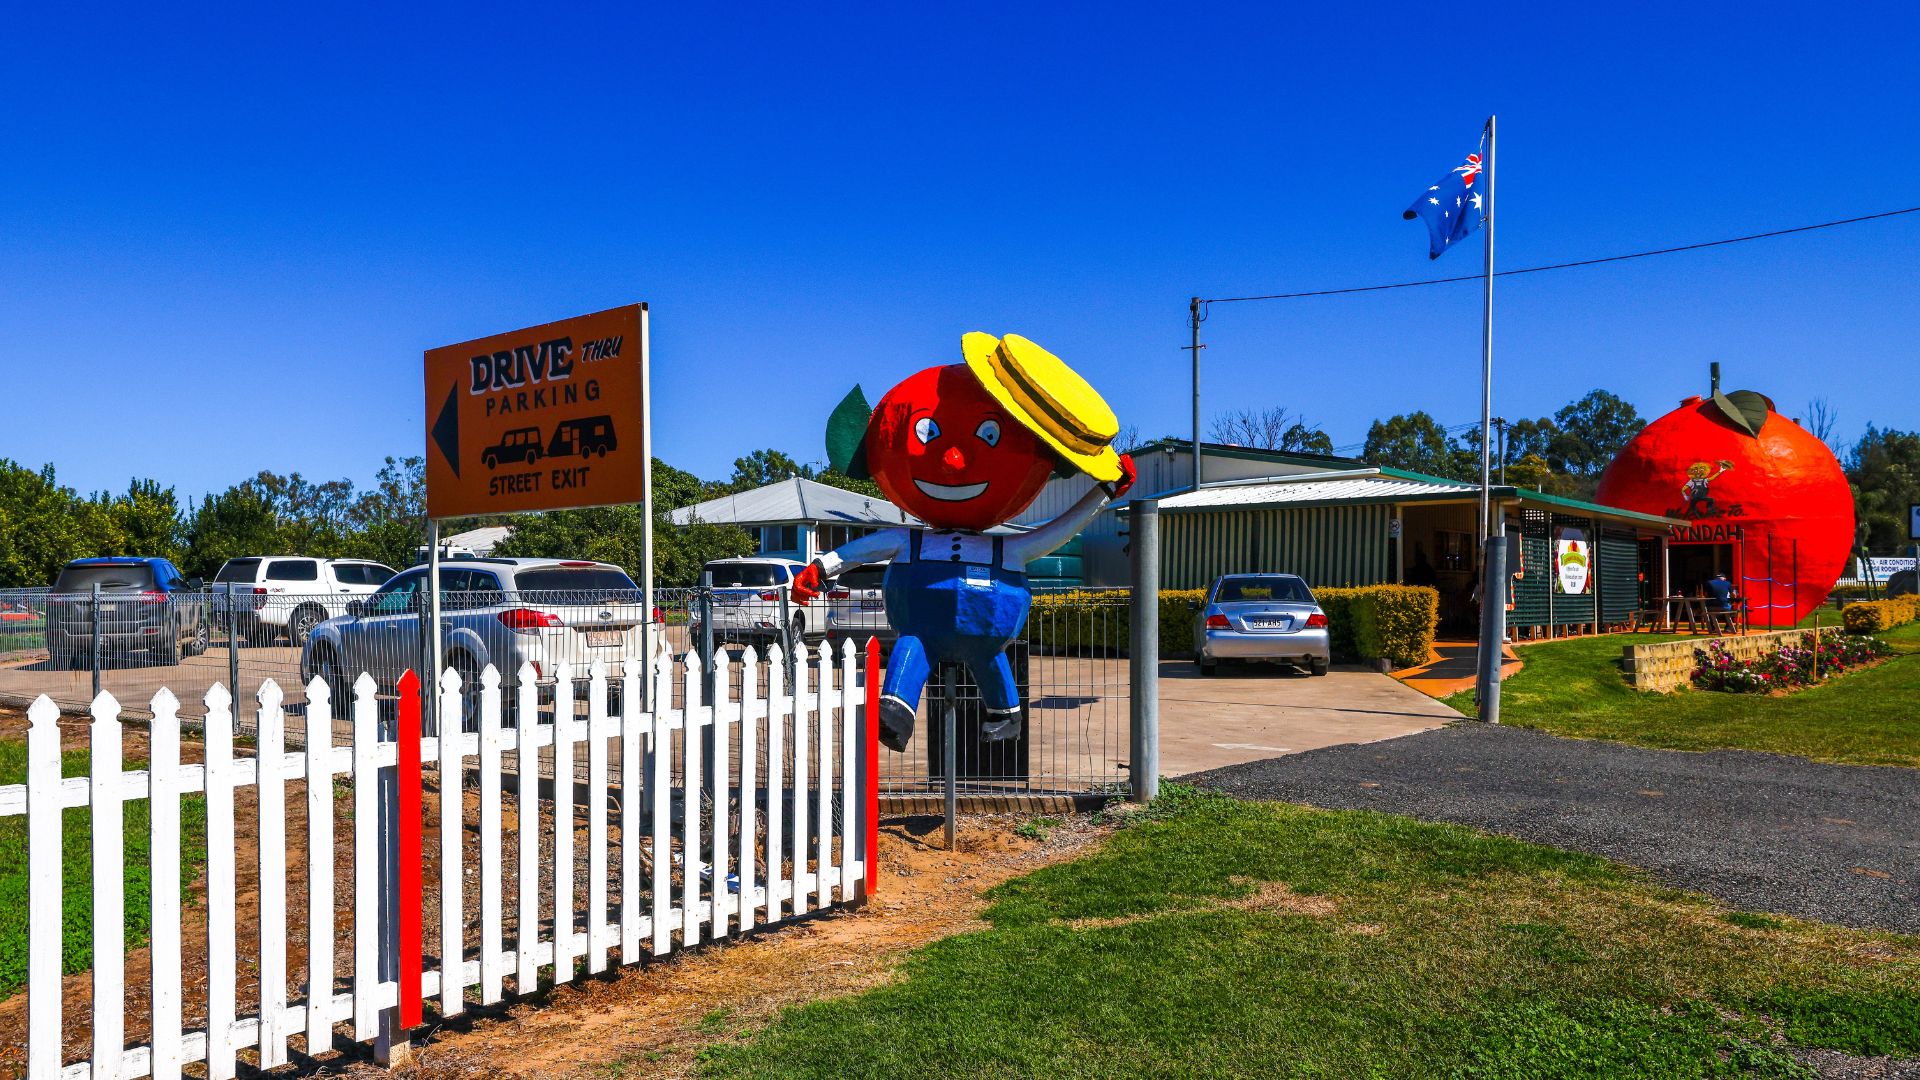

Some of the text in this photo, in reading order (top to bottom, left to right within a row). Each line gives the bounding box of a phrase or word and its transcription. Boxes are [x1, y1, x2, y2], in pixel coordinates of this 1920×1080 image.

[470, 336, 623, 395] DRIVE THRU
[486, 379, 601, 416] PARKING
[489, 466, 590, 496] STREET EXIT
[1666, 524, 1741, 541] AYNDAH
